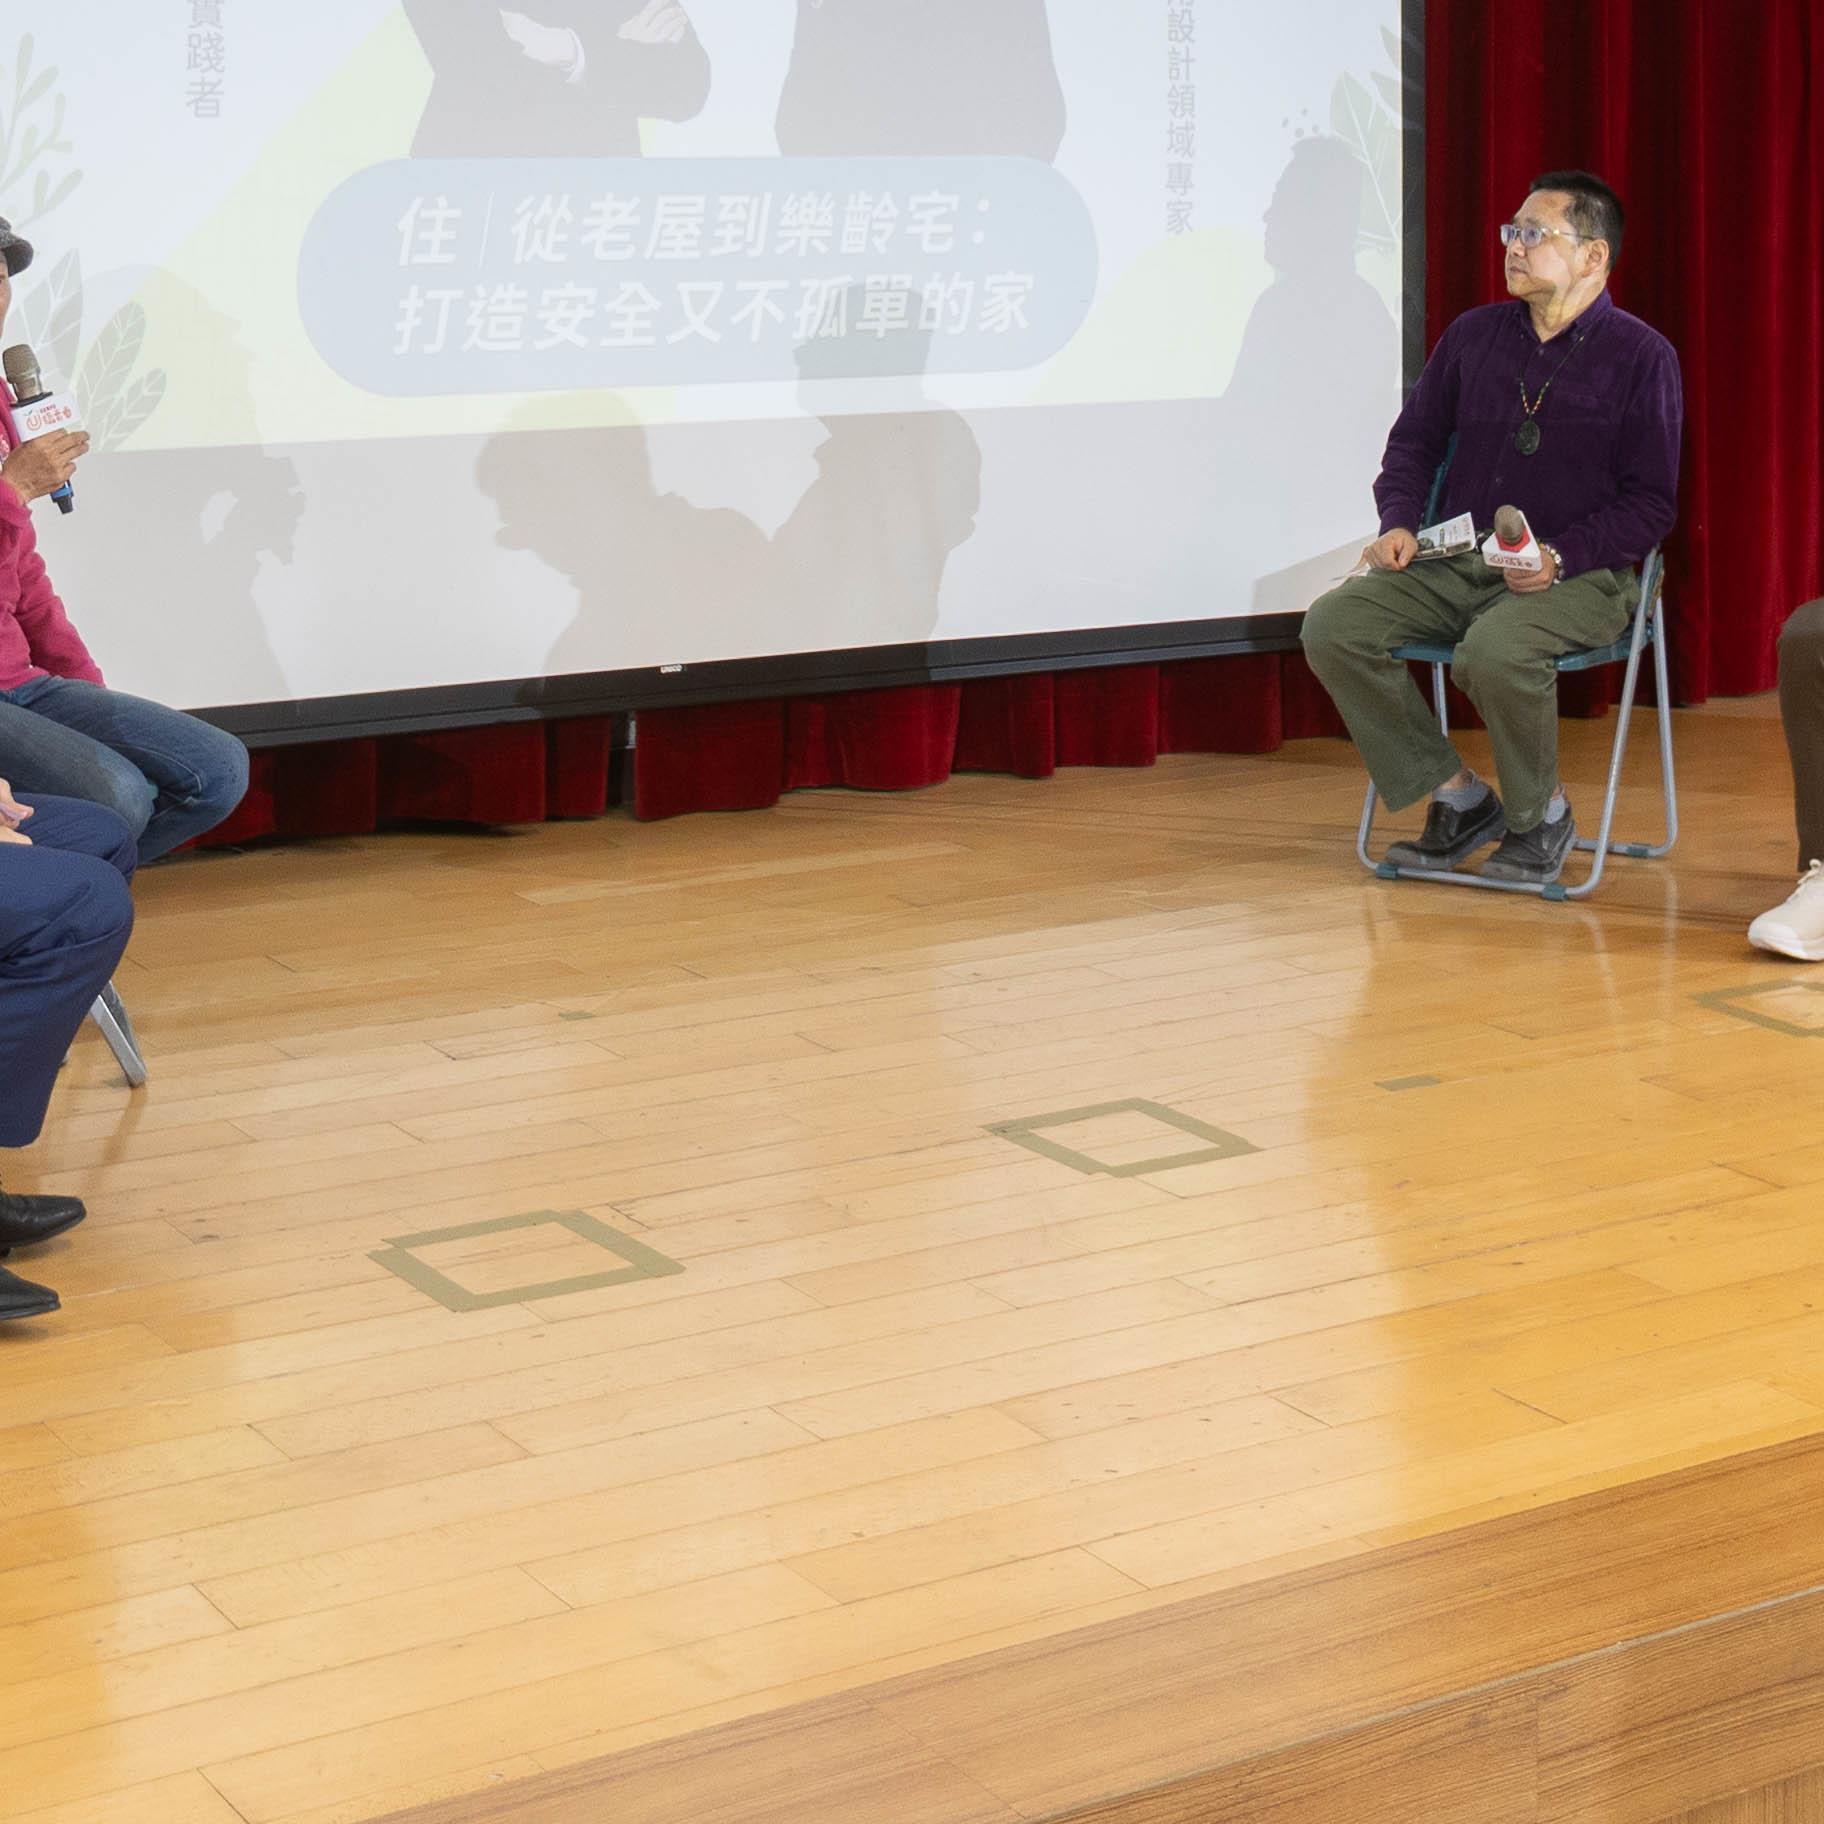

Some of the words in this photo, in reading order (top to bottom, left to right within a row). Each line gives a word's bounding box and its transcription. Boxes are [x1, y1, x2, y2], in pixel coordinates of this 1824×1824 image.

[394, 271, 1034, 355] 打造安全又不孤單的家
